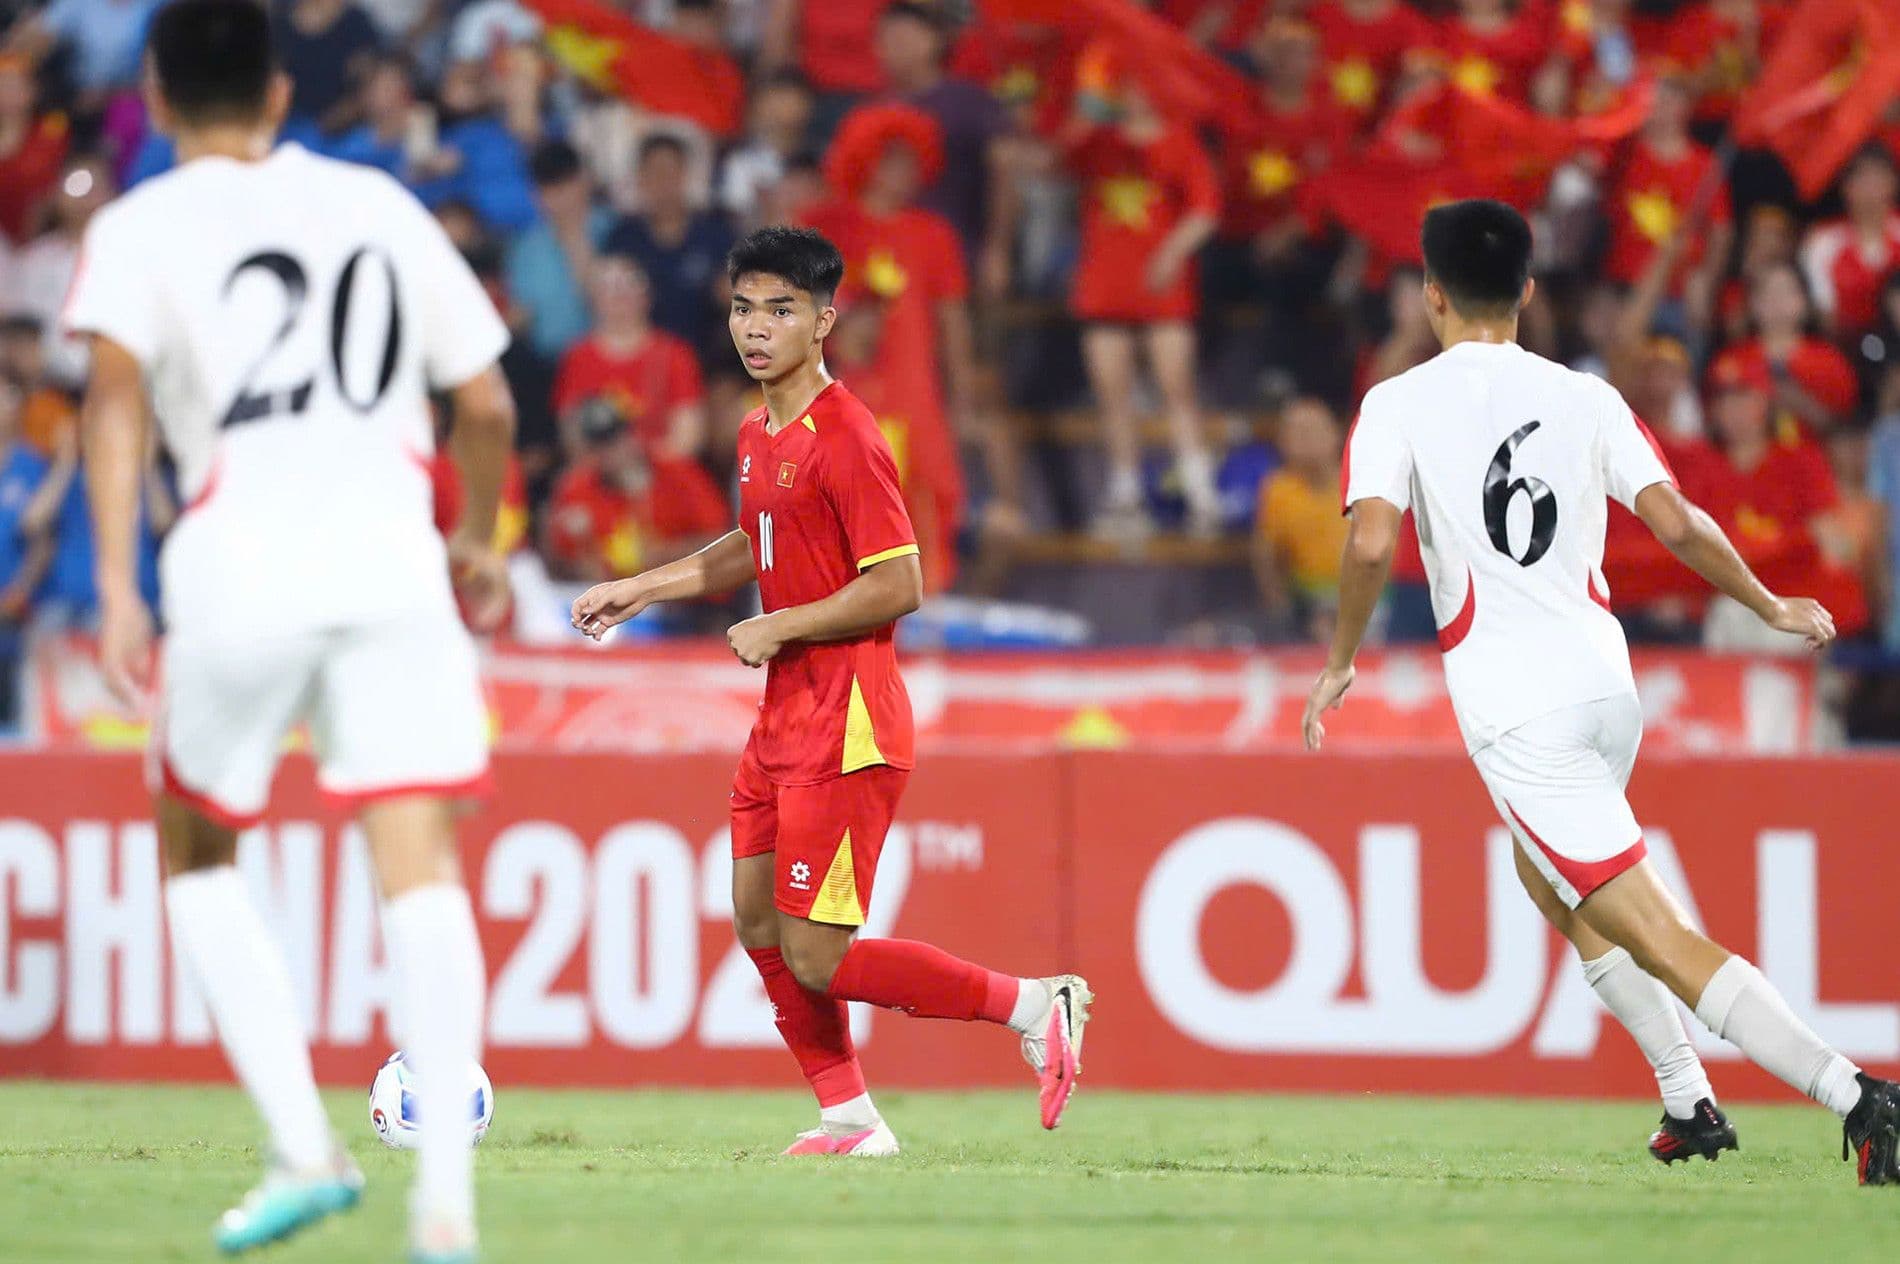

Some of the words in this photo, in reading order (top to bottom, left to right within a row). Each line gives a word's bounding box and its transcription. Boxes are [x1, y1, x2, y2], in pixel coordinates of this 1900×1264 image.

[220, 246, 403, 429] 20
[759, 509, 773, 572] 10
[1483, 420, 1557, 567] 6
